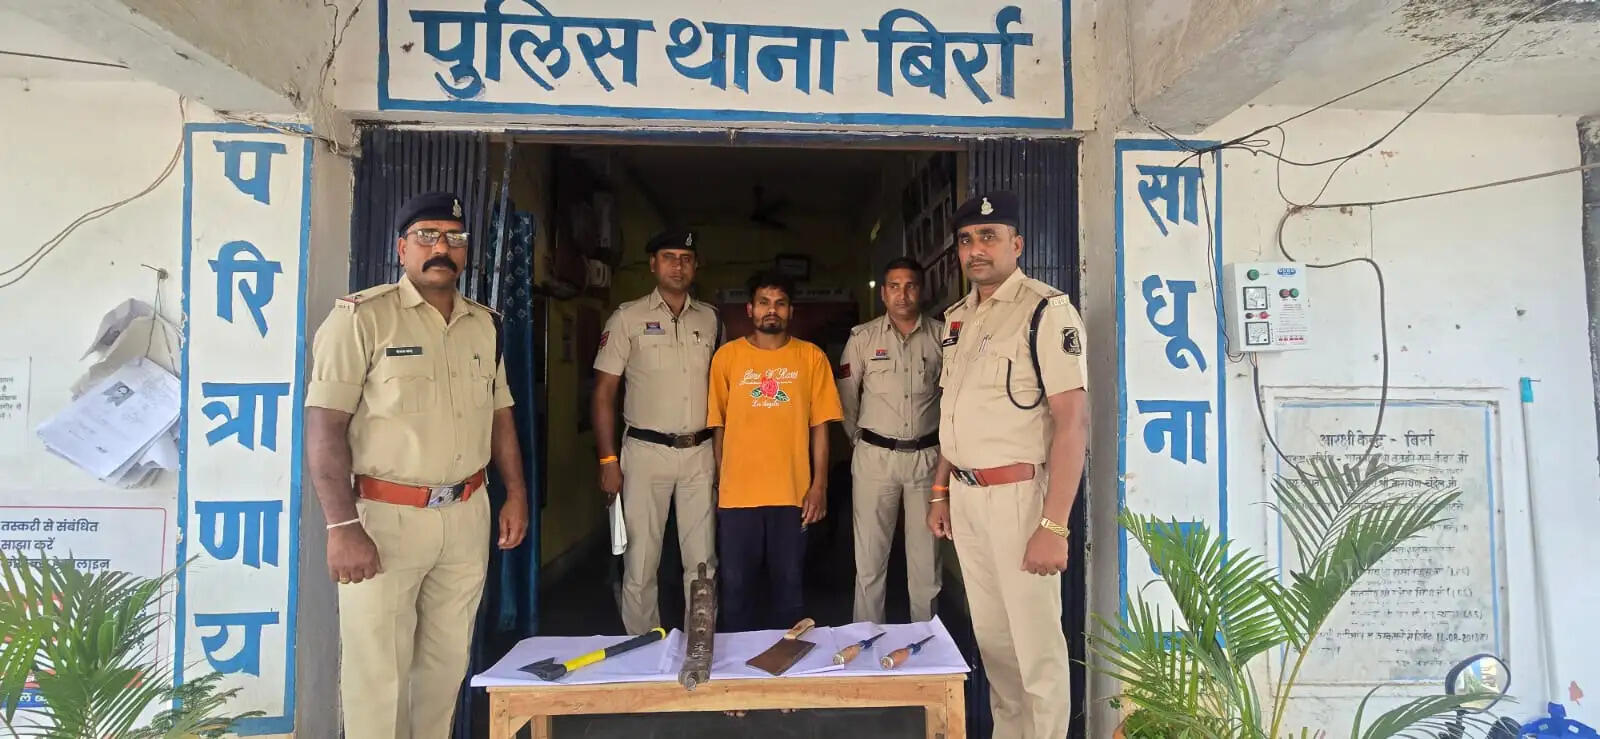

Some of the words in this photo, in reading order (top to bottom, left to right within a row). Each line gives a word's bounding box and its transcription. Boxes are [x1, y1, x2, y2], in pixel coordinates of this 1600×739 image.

[411, 0, 655, 99] पुलिस
[665, 17, 850, 95] थाना
[863, 6, 1034, 105] बिर्रा
[1, 517, 40, 532] तस्करी
[43, 518, 54, 532] से
[56, 517, 99, 532] संबंधित
[1, 539, 31, 551] साझा
